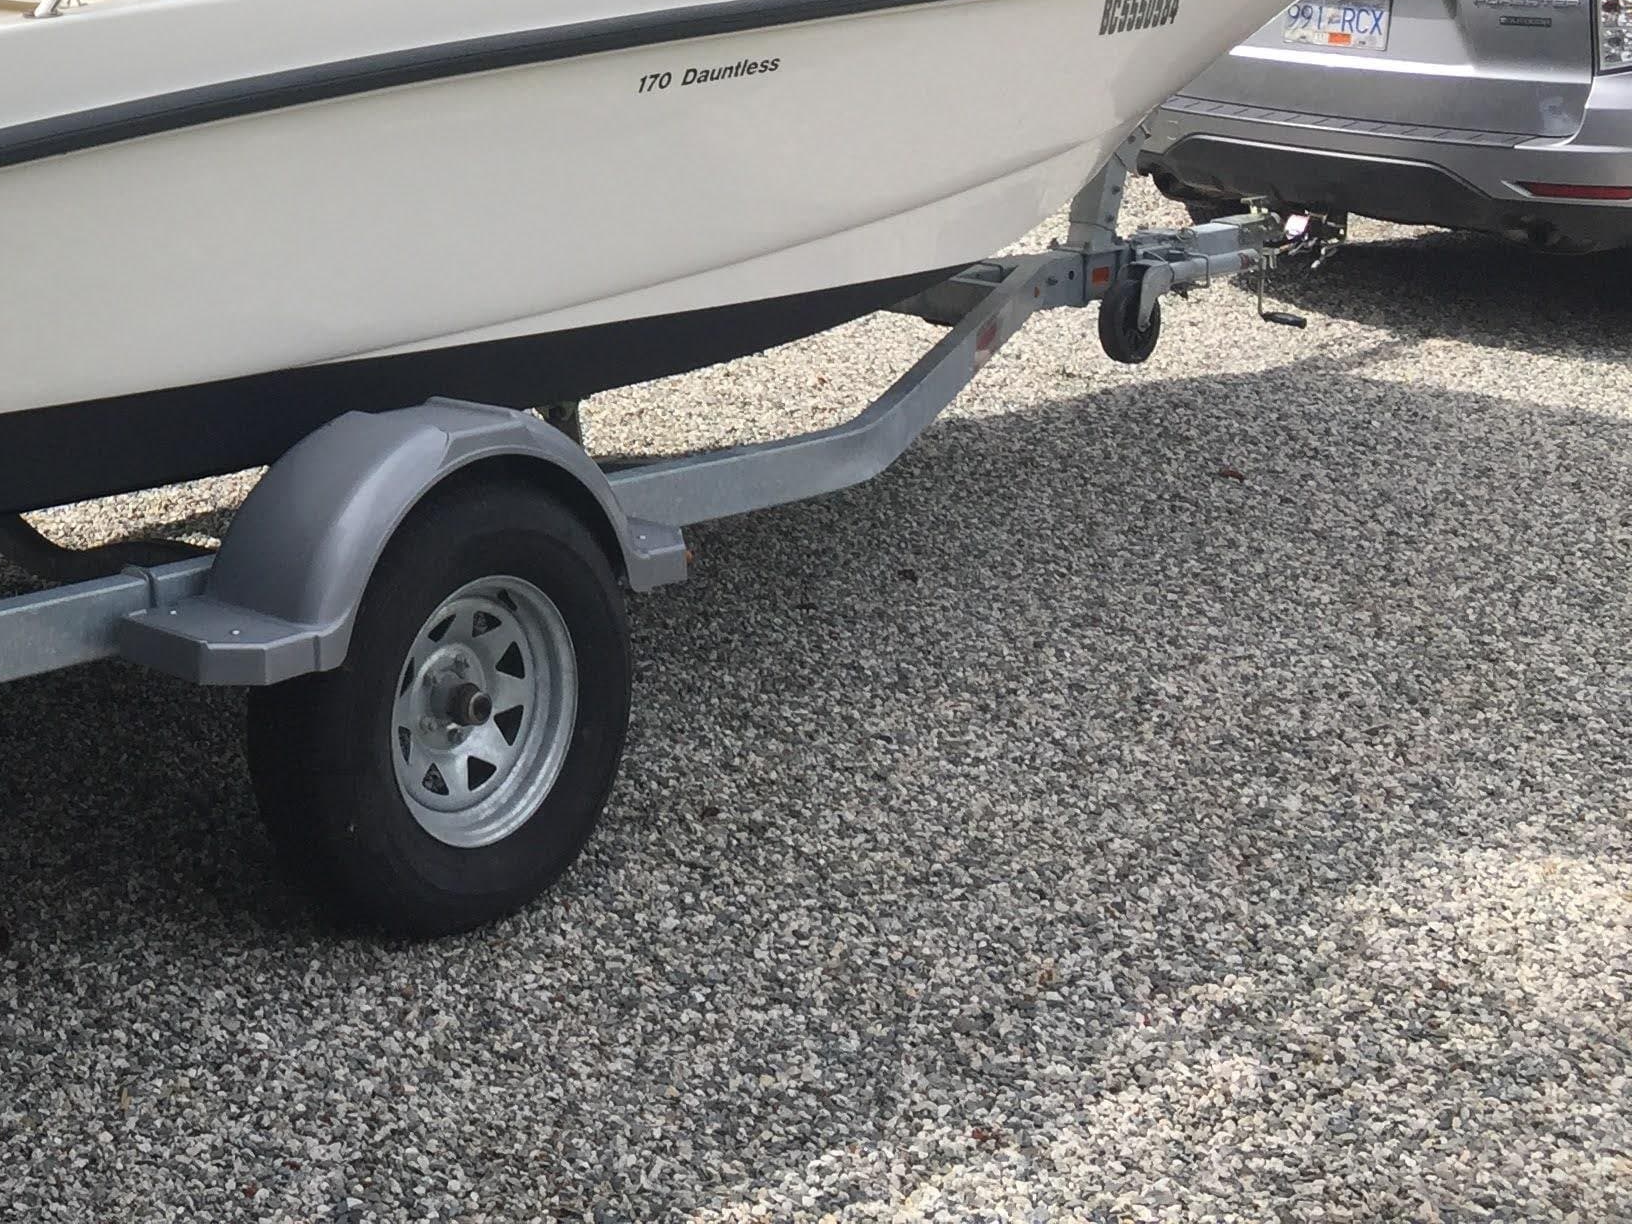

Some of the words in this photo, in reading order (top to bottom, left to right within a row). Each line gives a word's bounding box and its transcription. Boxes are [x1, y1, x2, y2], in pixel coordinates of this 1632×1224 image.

[1288, 4, 1323, 30] 991
[1341, 7, 1385, 35] RCX
[638, 71, 672, 93] 170
[681, 57, 781, 86] Dauntless
